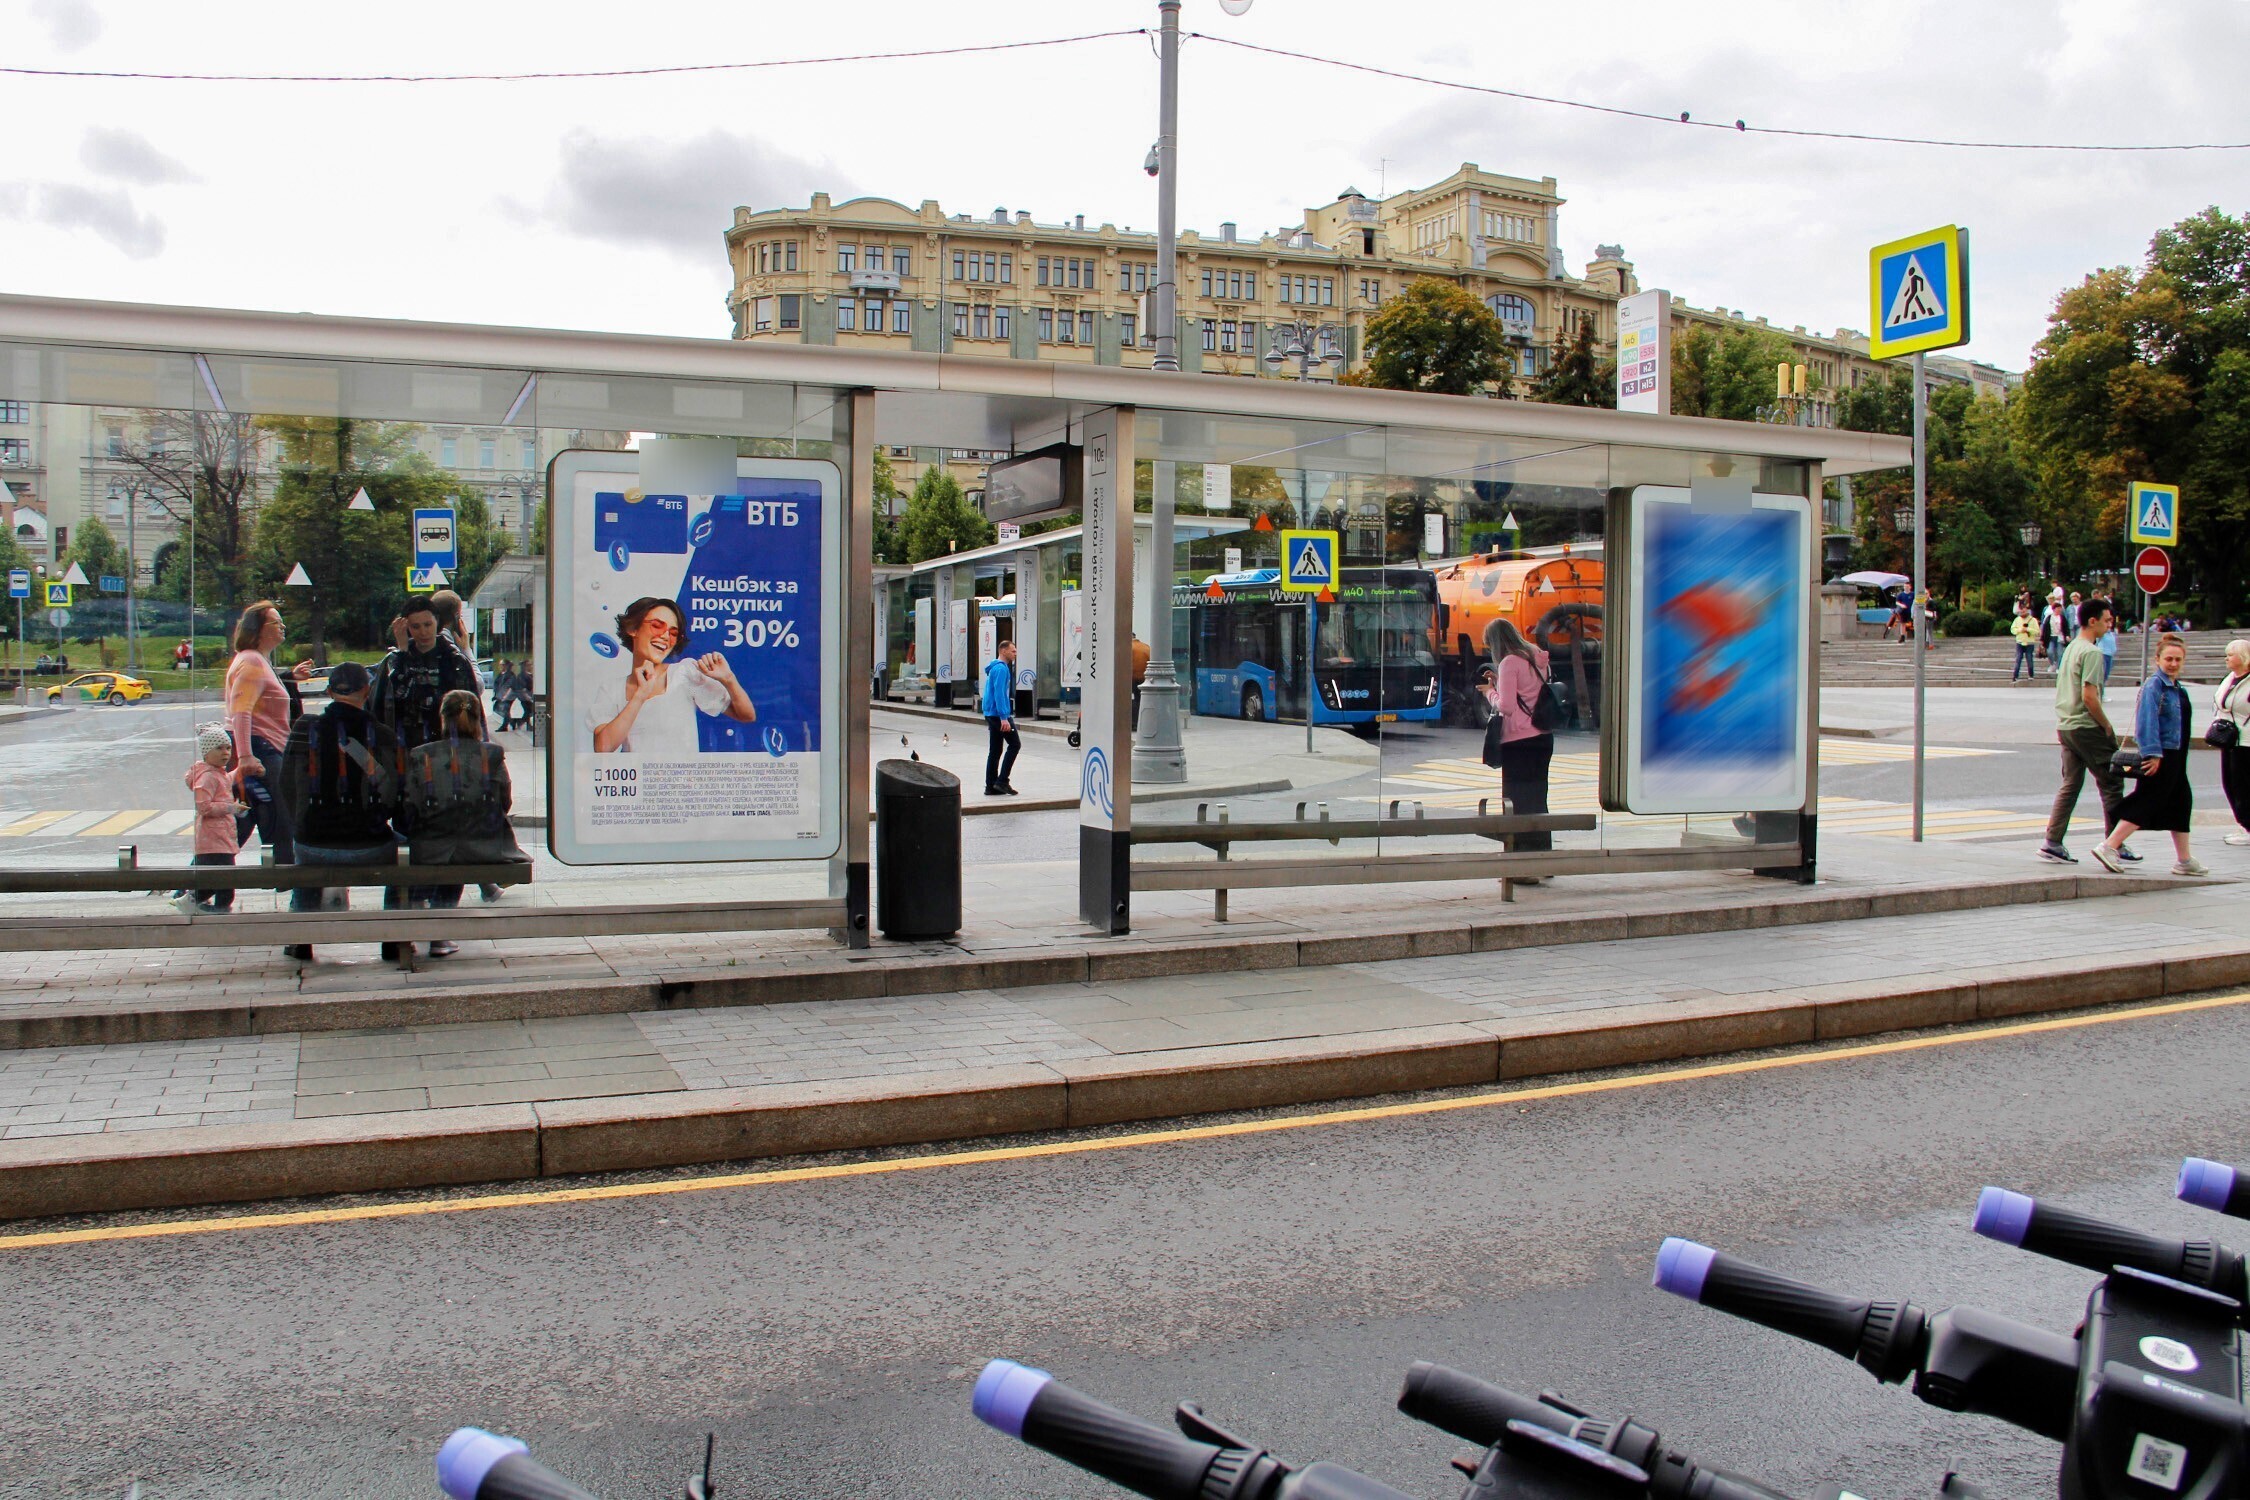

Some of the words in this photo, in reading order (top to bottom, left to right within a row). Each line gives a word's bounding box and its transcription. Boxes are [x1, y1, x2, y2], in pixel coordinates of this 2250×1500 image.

[665, 501, 683, 510] ВТБ
[748, 502, 799, 526] ВТБ
[692, 576, 771, 593] Кешбэк
[776, 580, 798, 594] за
[1344, 587, 1364, 597] м40
[692, 598, 783, 614] покупки
[690, 616, 718, 632] до
[723, 620, 800, 648] 30%
[605, 769, 637, 781] 1000
[595, 786, 637, 797] VTB.RU
